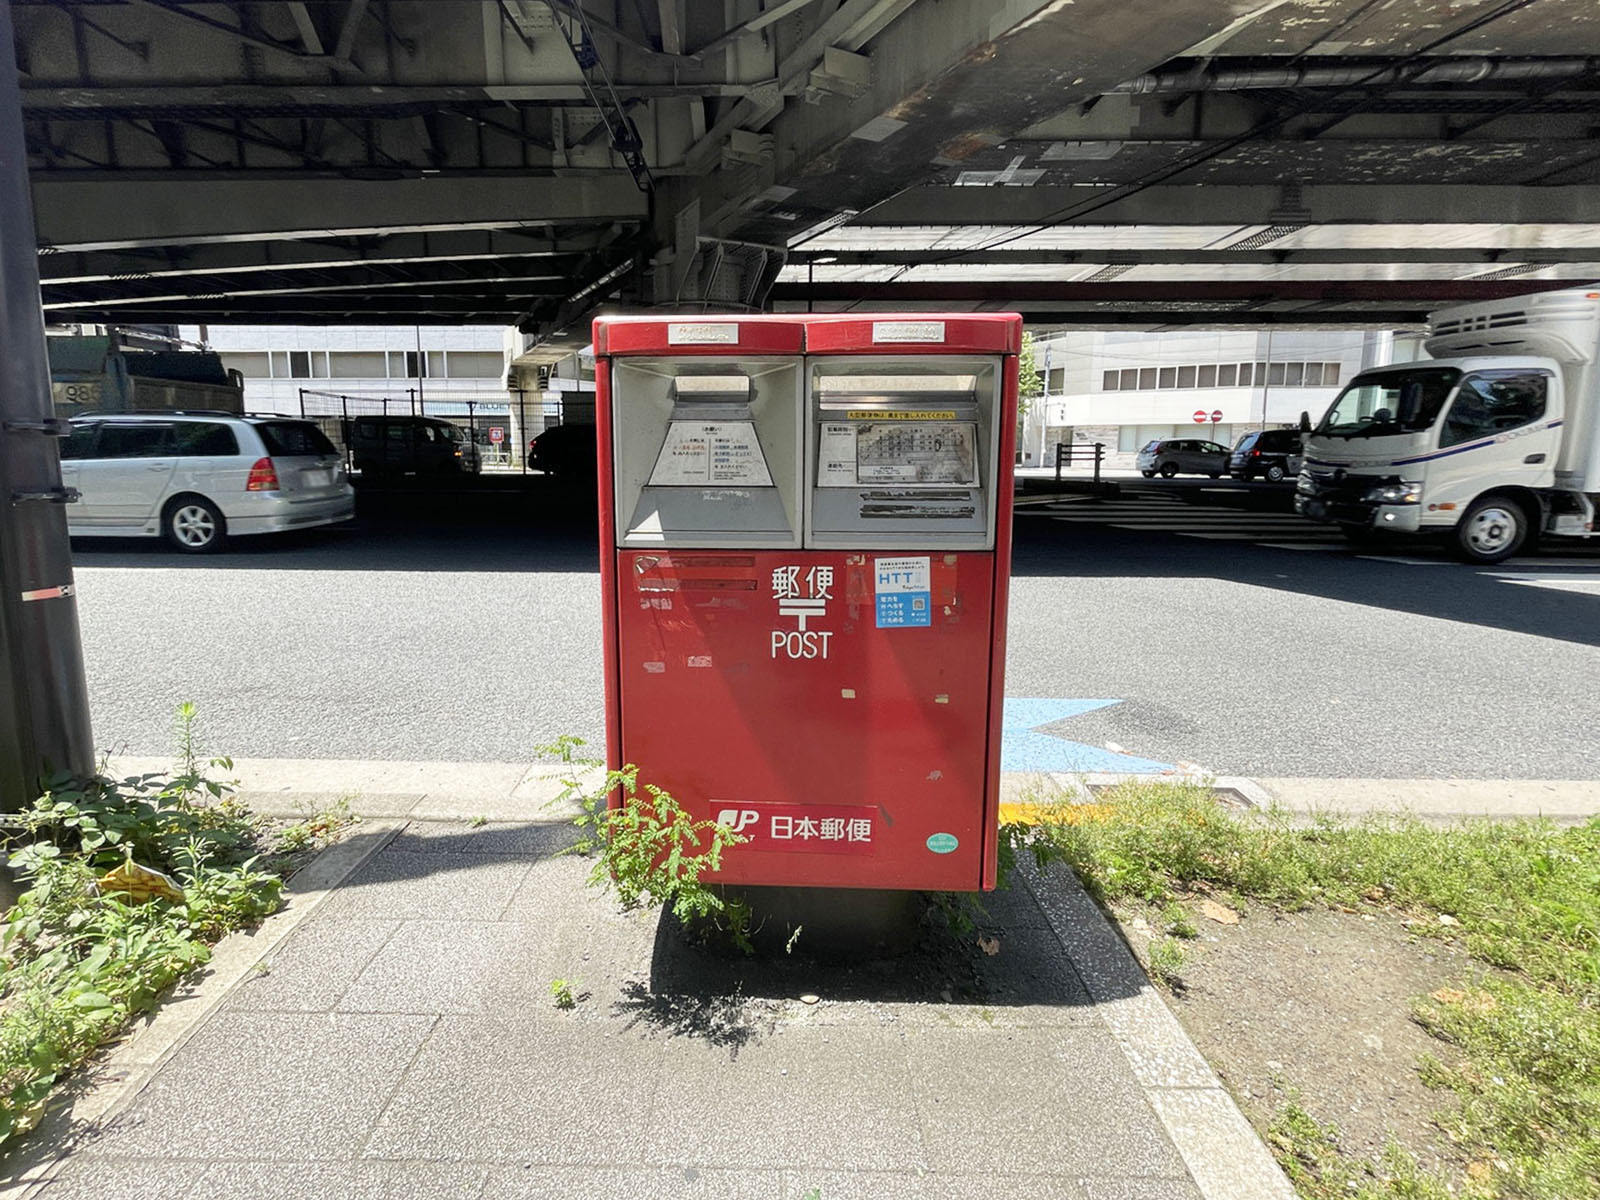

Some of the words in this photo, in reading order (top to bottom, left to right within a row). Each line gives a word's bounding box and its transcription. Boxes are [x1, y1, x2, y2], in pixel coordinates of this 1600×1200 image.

[772, 566, 834, 600] 郵便
[879, 572, 912, 584] HTT
[771, 630, 834, 660] POST
[771, 815, 872, 843] 日本郵便
